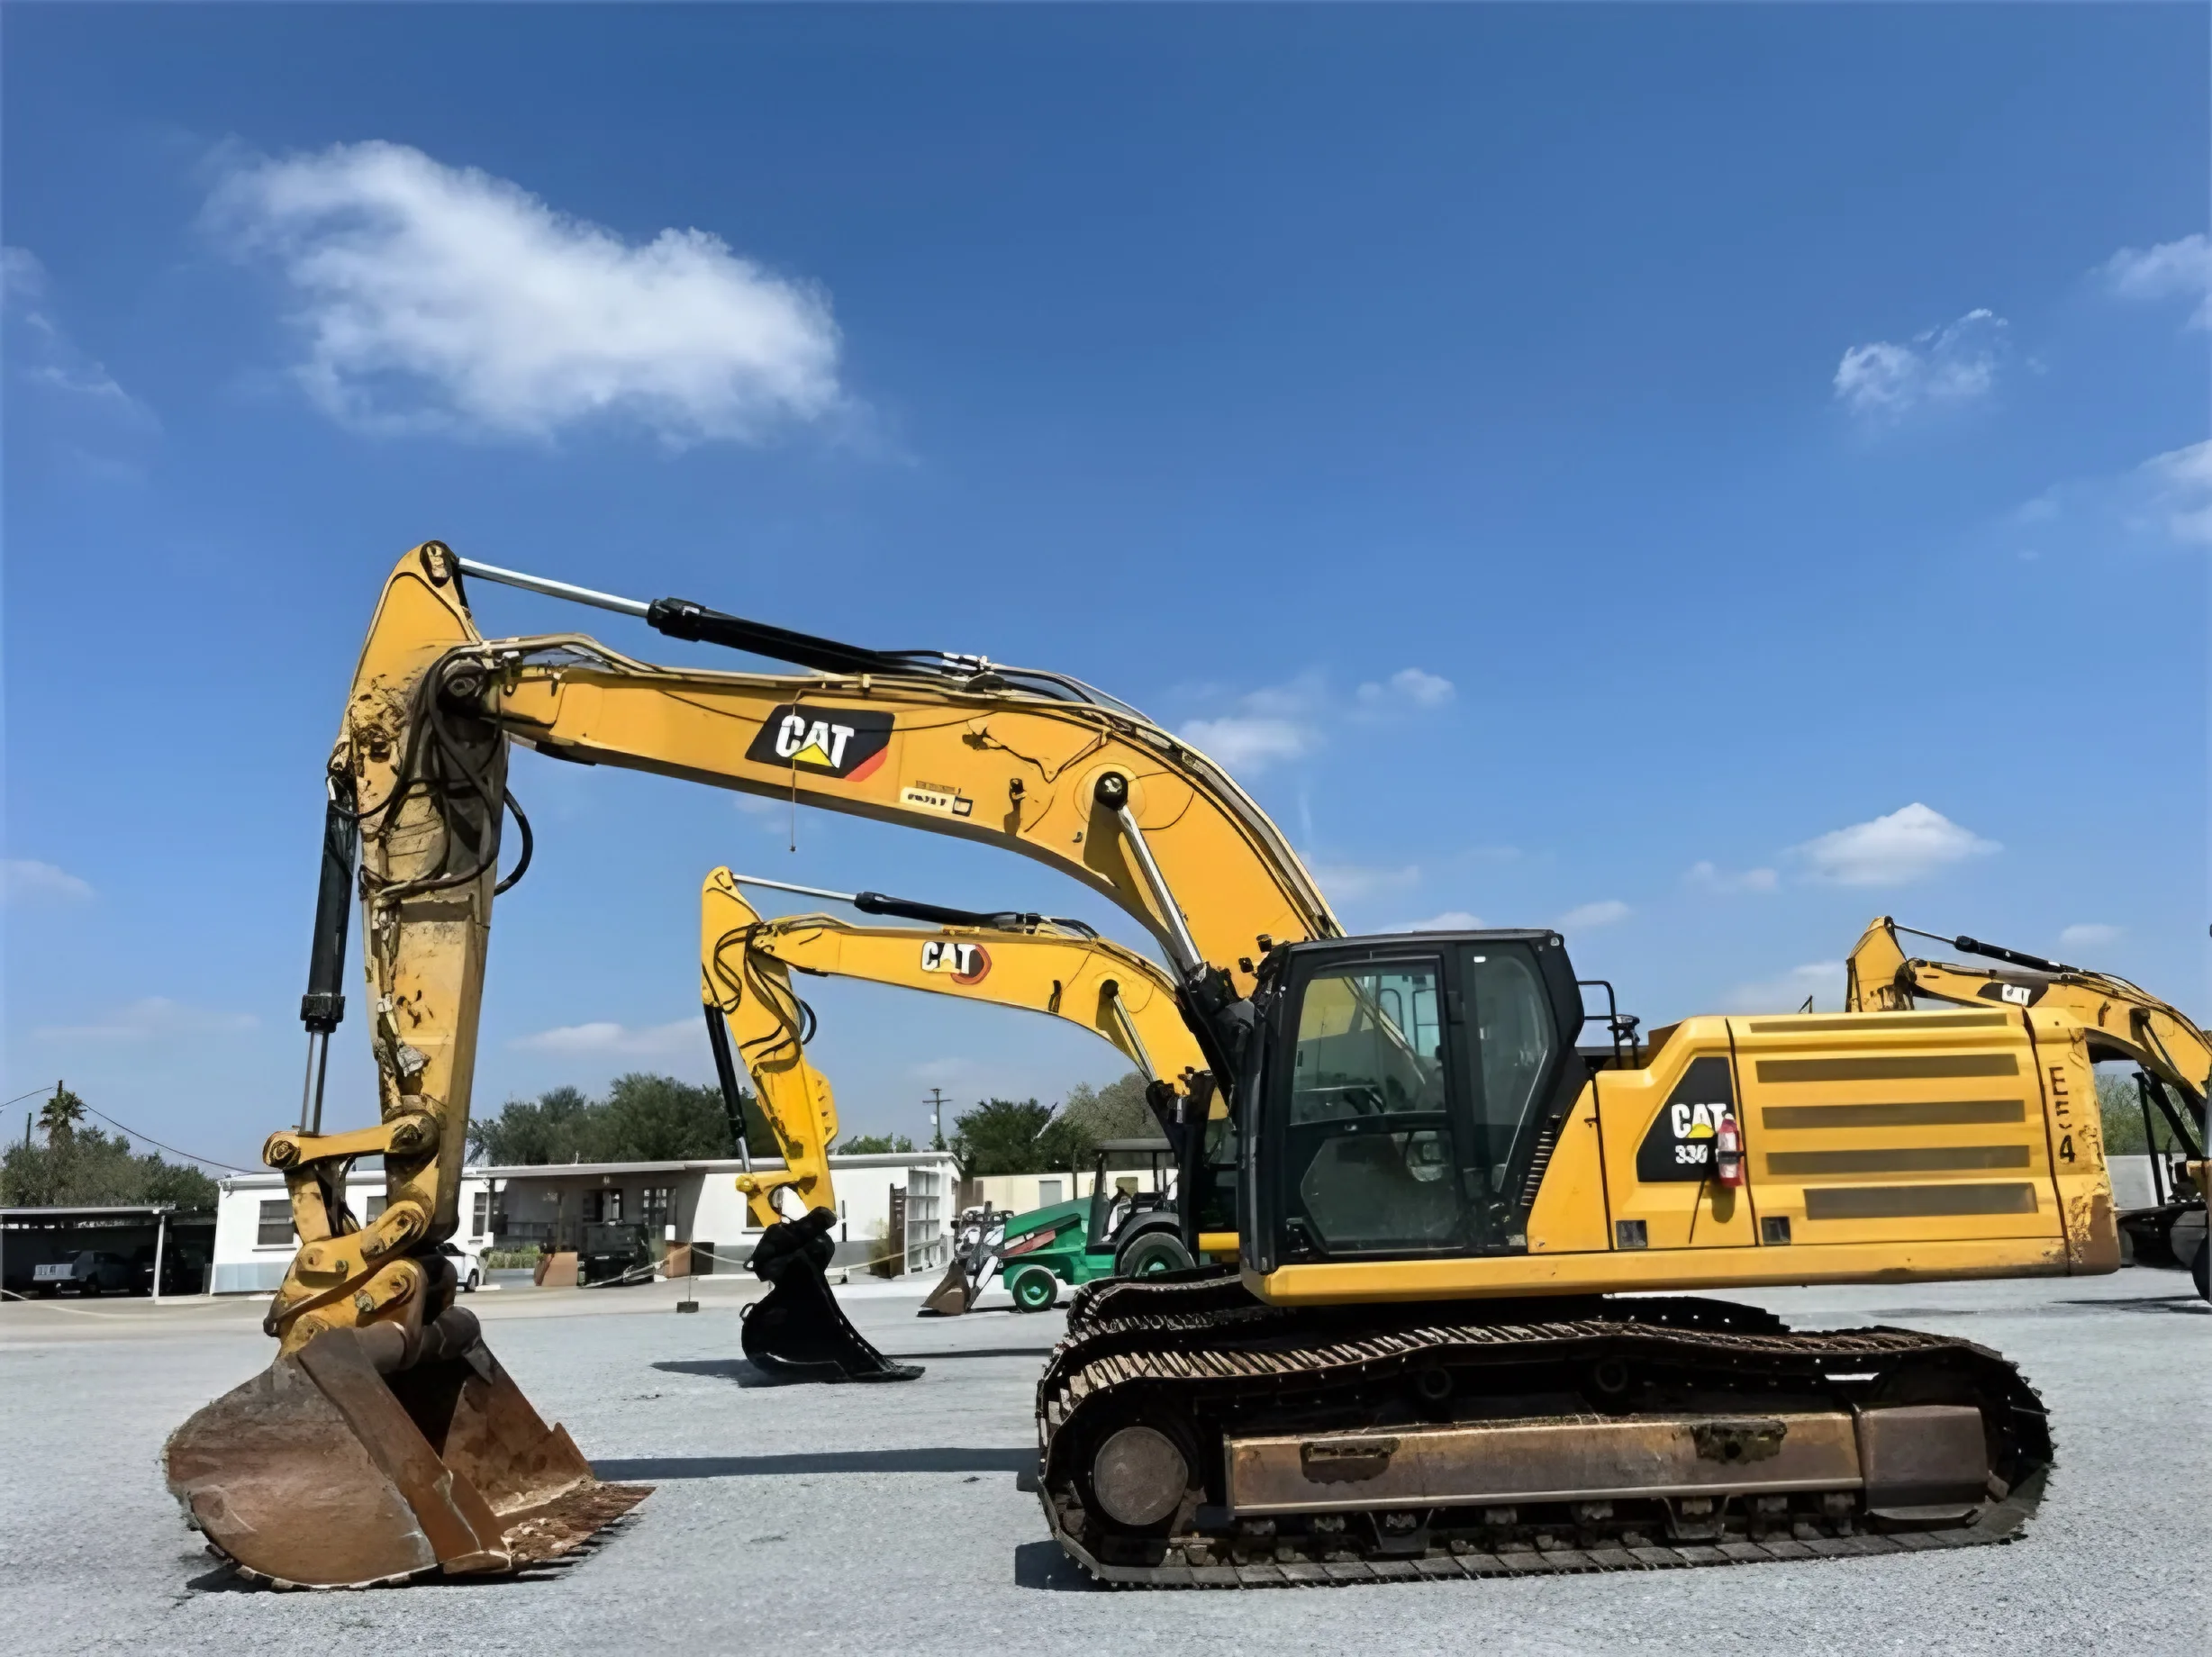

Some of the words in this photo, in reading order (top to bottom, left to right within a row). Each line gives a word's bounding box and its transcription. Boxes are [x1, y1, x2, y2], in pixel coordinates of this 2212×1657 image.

[775, 715, 855, 769] CAT
[921, 941, 976, 974] CAT
[1671, 1103, 1727, 1138] CAT
